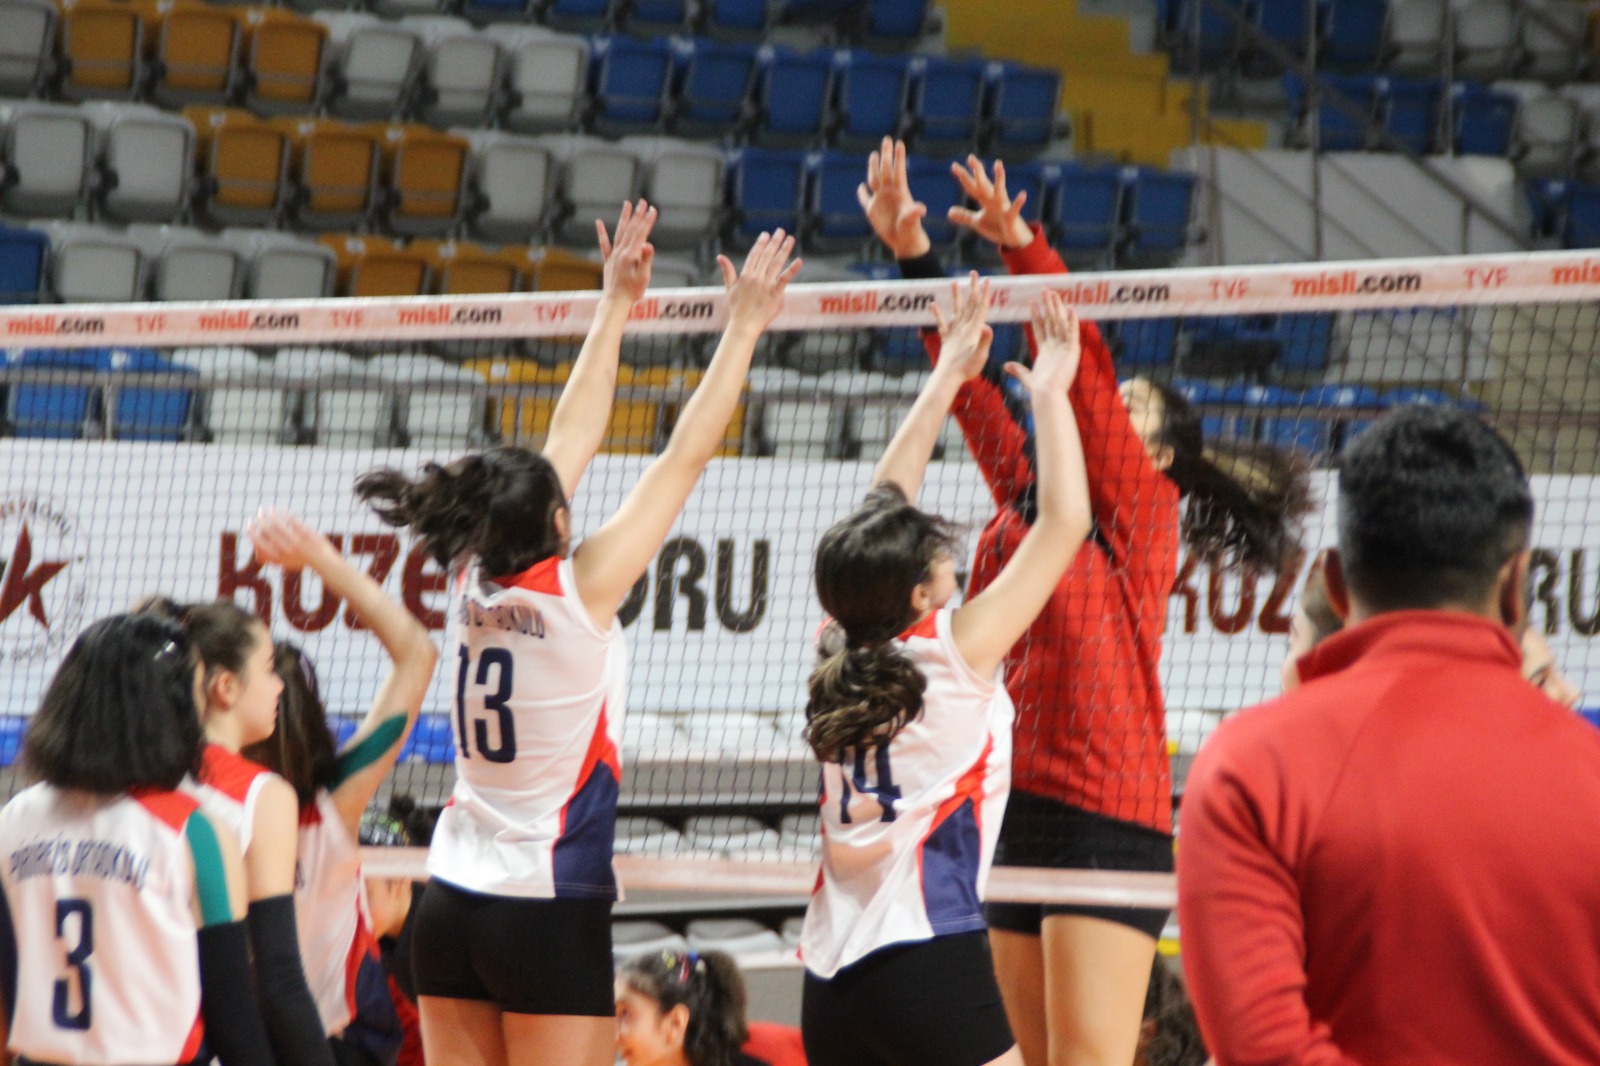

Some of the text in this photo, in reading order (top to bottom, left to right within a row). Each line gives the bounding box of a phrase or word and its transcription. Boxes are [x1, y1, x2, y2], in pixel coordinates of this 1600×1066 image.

[7, 314, 105, 335] misli.com
[134, 315, 166, 334] TVF
[198, 310, 299, 331] misli.com
[330, 309, 364, 328] TVF
[398, 304, 501, 326] misli.com
[532, 302, 571, 322] TVF
[627, 297, 714, 321] isli.com
[818, 292, 935, 314] misli.com
[1209, 278, 1250, 300] TVF
[1291, 271, 1421, 298] misli.com
[1463, 266, 1508, 289] TVF
[456, 643, 517, 764] 13
[52, 897, 94, 1031] 3
